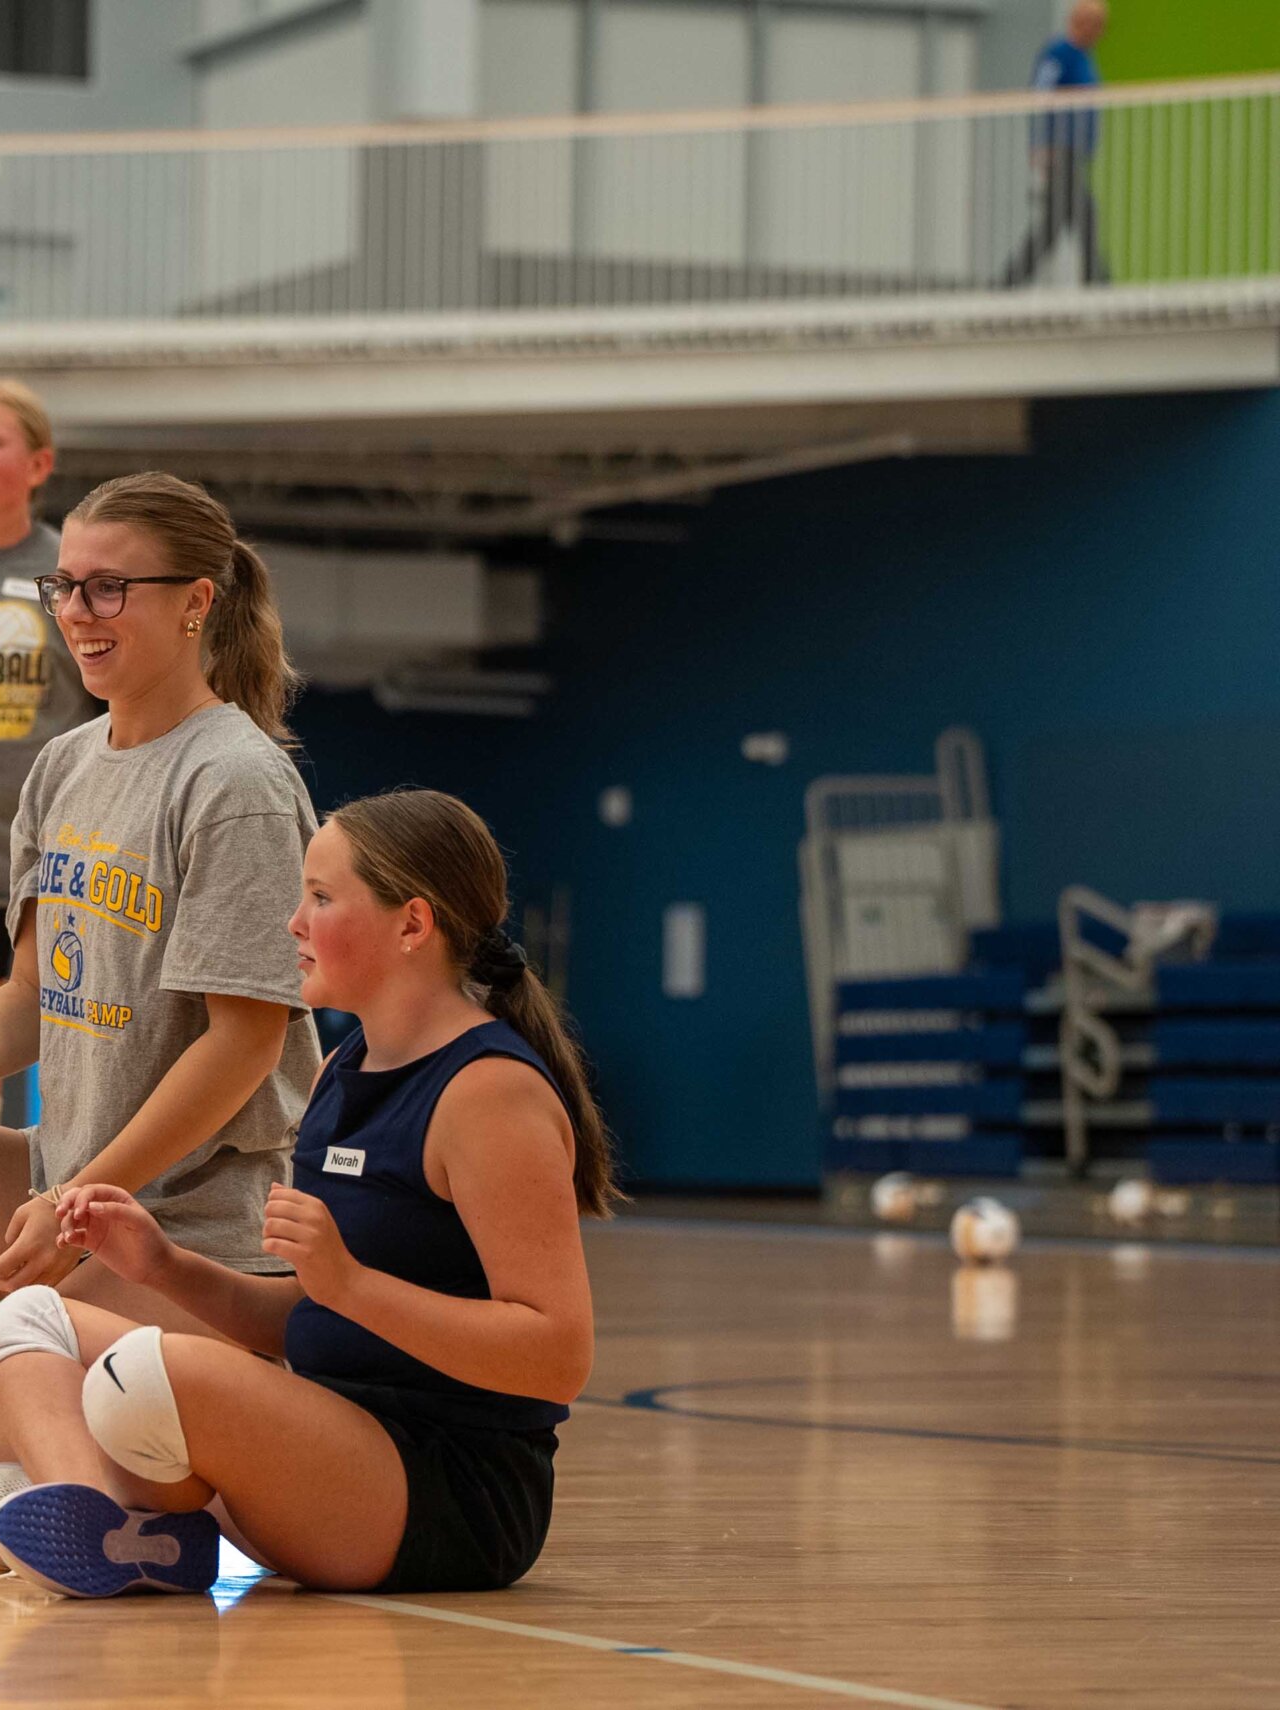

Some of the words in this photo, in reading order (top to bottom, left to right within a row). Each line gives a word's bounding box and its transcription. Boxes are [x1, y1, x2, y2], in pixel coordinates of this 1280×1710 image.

[40, 852, 70, 894] UE
[69, 861, 85, 898] &
[89, 860, 164, 933] GOLD
[40, 987, 85, 1019] EYBALL
[85, 998, 132, 1029] CAMP
[330, 1152, 359, 1168] Norah
